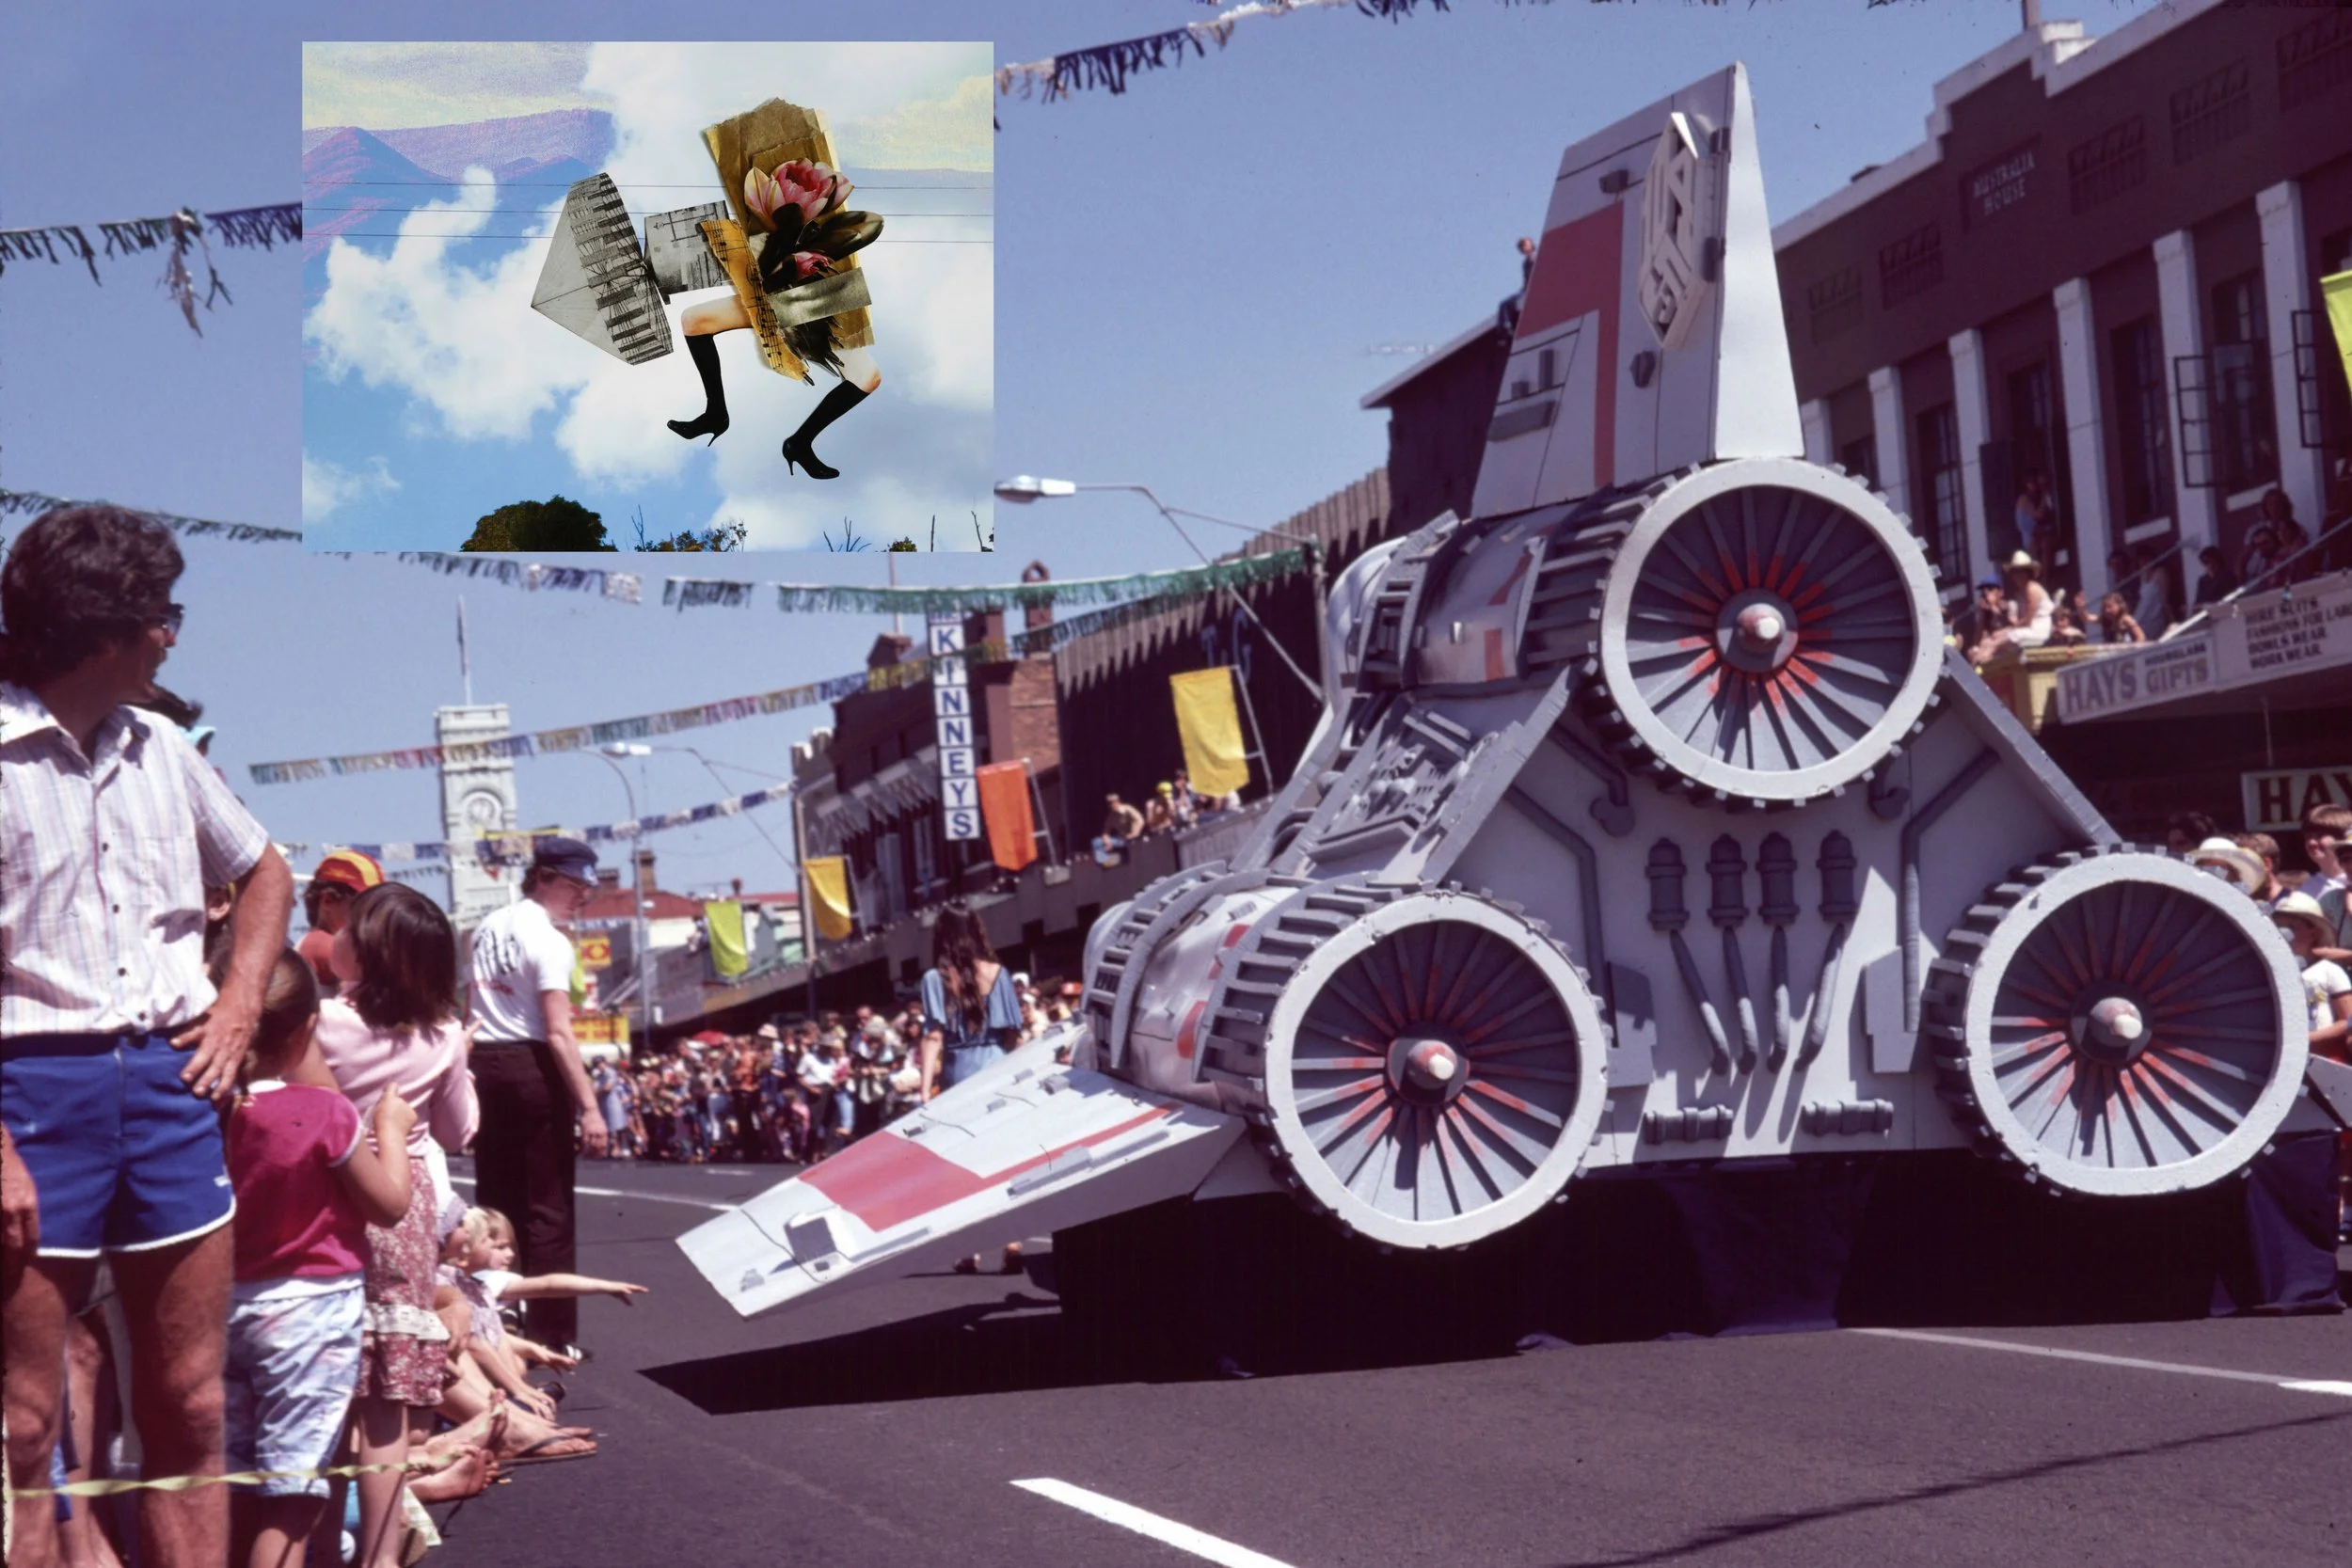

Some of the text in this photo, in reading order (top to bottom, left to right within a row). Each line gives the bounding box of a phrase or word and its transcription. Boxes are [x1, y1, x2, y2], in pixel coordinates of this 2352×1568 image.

[1974, 150, 2036, 198] AUSTRALIA
[1983, 177, 2026, 215] HOUSE
[2246, 619, 2299, 641] FASHIONS
[2302, 611, 2324, 627] FOR
[2248, 626, 2327, 656] BOWLS WEAR
[2249, 642, 2322, 669] WORK WEAR
[2062, 661, 2137, 712] HAYS
[2146, 660, 2208, 693] GIFTS
[938, 628, 972, 838] KINNEYS
